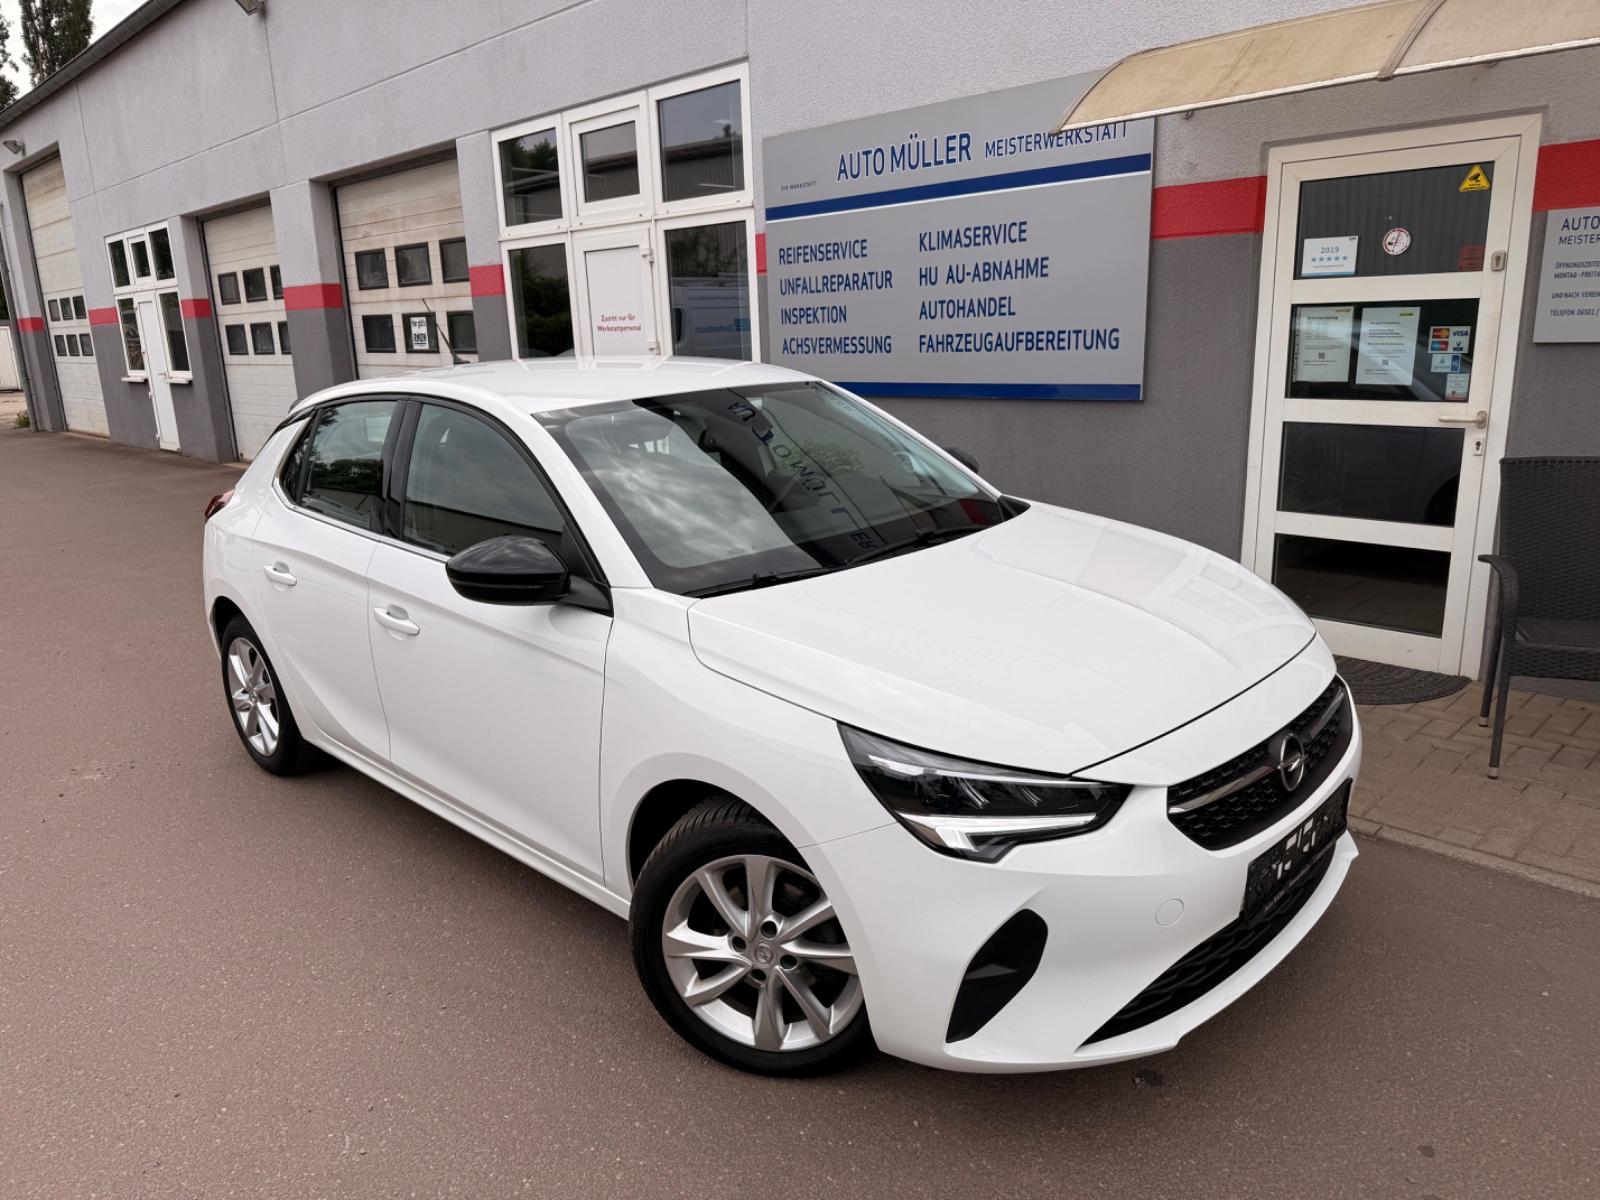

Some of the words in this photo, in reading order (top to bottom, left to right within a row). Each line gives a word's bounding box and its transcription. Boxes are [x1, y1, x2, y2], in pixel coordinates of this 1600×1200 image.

[837, 147, 885, 181] AUTO
[890, 132, 972, 173] MÜLLER
[985, 121, 1128, 158] MEISTERWERKSTATT
[1561, 215, 1600, 231] AUTO
[918, 221, 1028, 252] KLIMASERVICE
[778, 239, 868, 265] REIFENSERVICE
[779, 270, 893, 296] UNFALLREPARATUR
[919, 266, 939, 287] HU
[946, 256, 1050, 286] AU-ABNAHME
[780, 305, 848, 326] INSPEKTION
[919, 296, 1016, 320] AUTOHANDEL
[782, 335, 892, 355] ACHSVERMESSUNG
[918, 328, 1120, 353] FAHRZEUGAUFBEREITUNG
